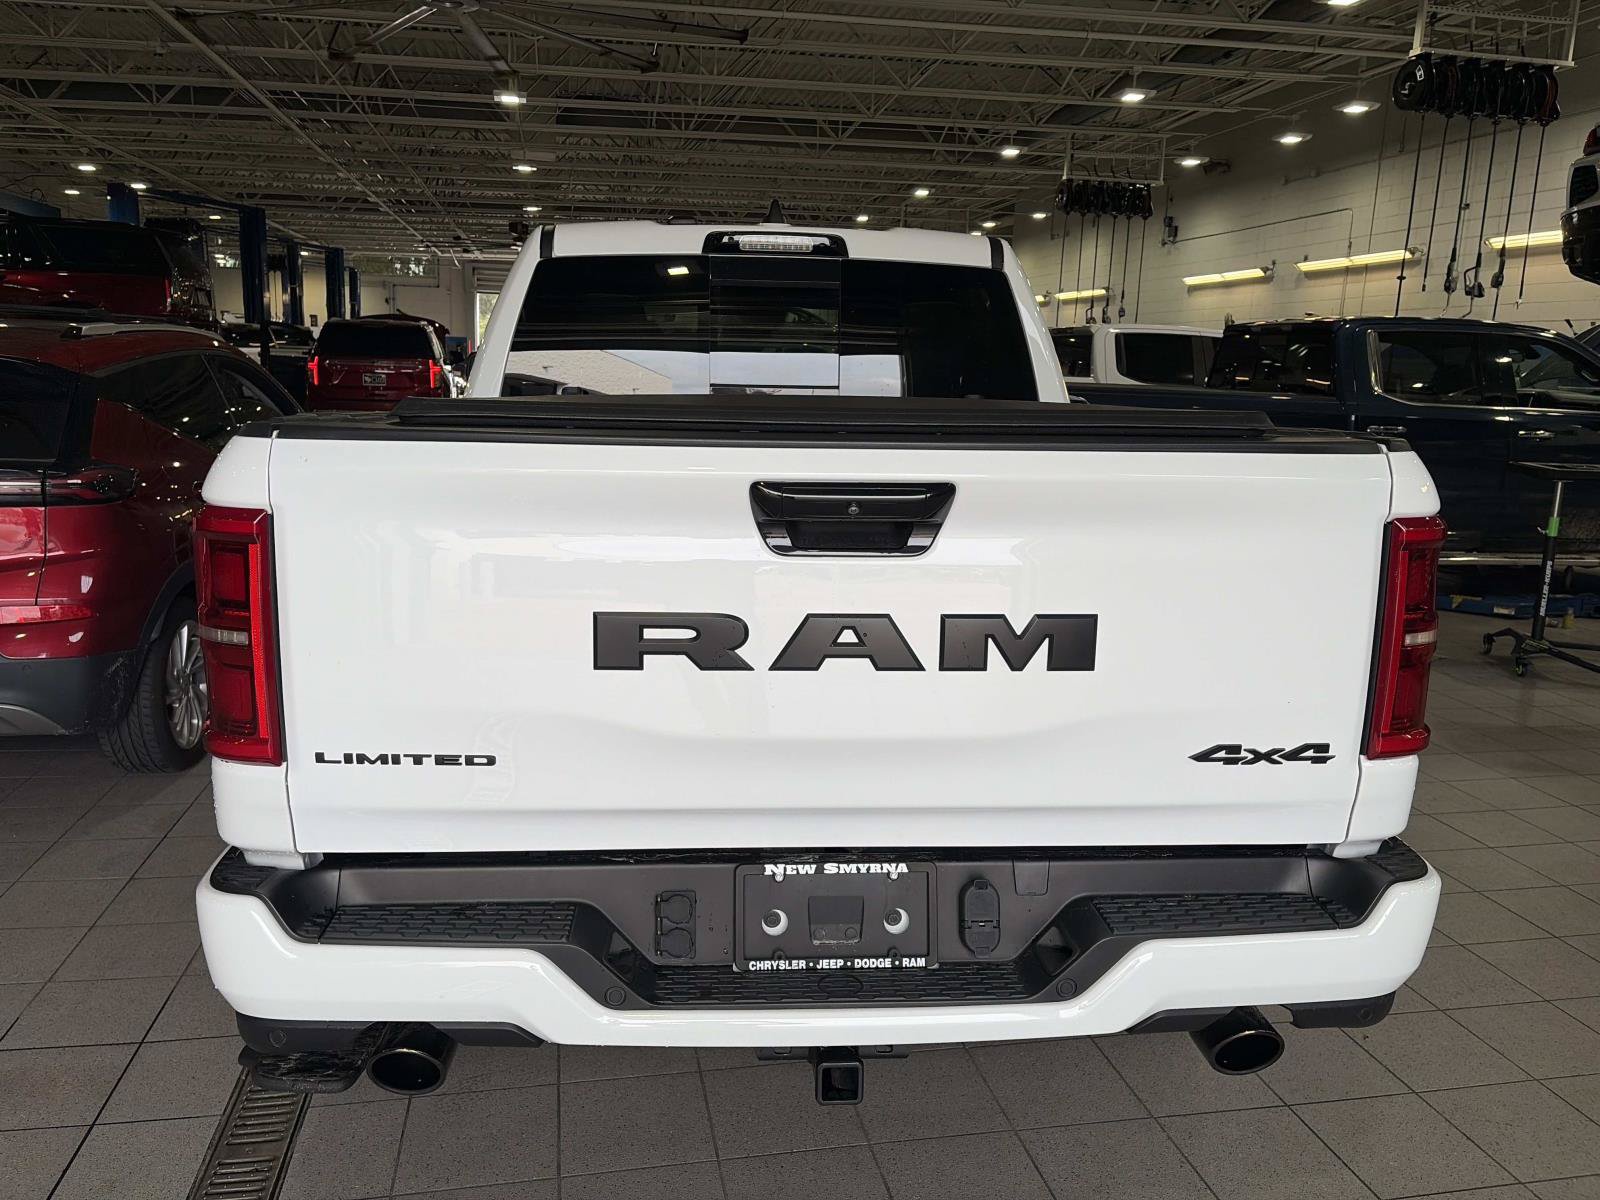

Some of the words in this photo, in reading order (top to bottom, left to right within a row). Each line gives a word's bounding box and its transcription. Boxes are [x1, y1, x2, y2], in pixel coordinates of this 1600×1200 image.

[592, 611, 1099, 672] RAM
[314, 751, 497, 767] LIMITED
[763, 862, 817, 876] NEW
[823, 862, 909, 875] SMYRNA
[748, 959, 807, 971] CHRYSLER
[816, 959, 844, 970] JEEP
[854, 958, 892, 969] DODGE
[902, 957, 926, 968] RAM
